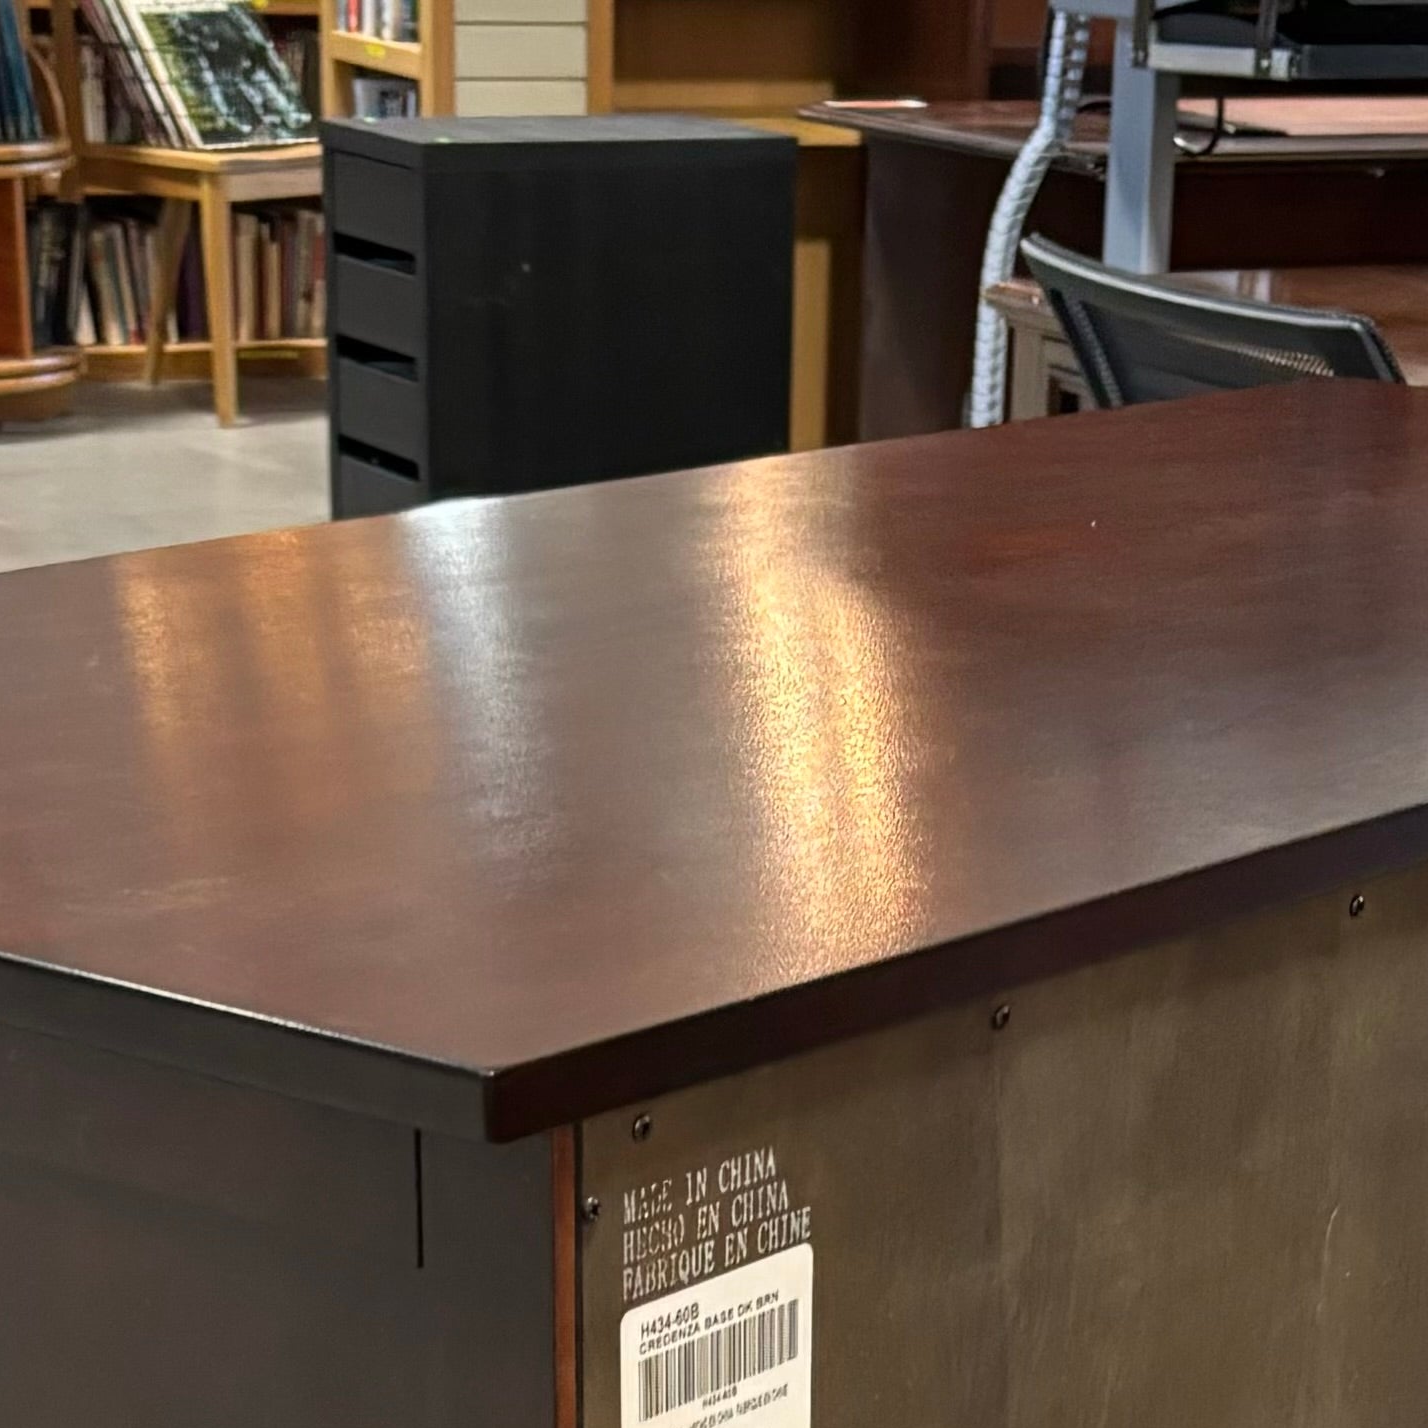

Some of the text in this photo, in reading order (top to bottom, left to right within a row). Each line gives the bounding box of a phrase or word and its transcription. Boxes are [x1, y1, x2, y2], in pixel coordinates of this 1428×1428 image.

[623, 1179, 789, 1265] HECHO EN CHINA
[624, 1146, 777, 1225] MADE IN CHINA
[622, 1206, 812, 1302] FABRIQUE EN CHINE
[639, 1321, 701, 1355] CREDENZA
[704, 1307, 734, 1329] BASE
